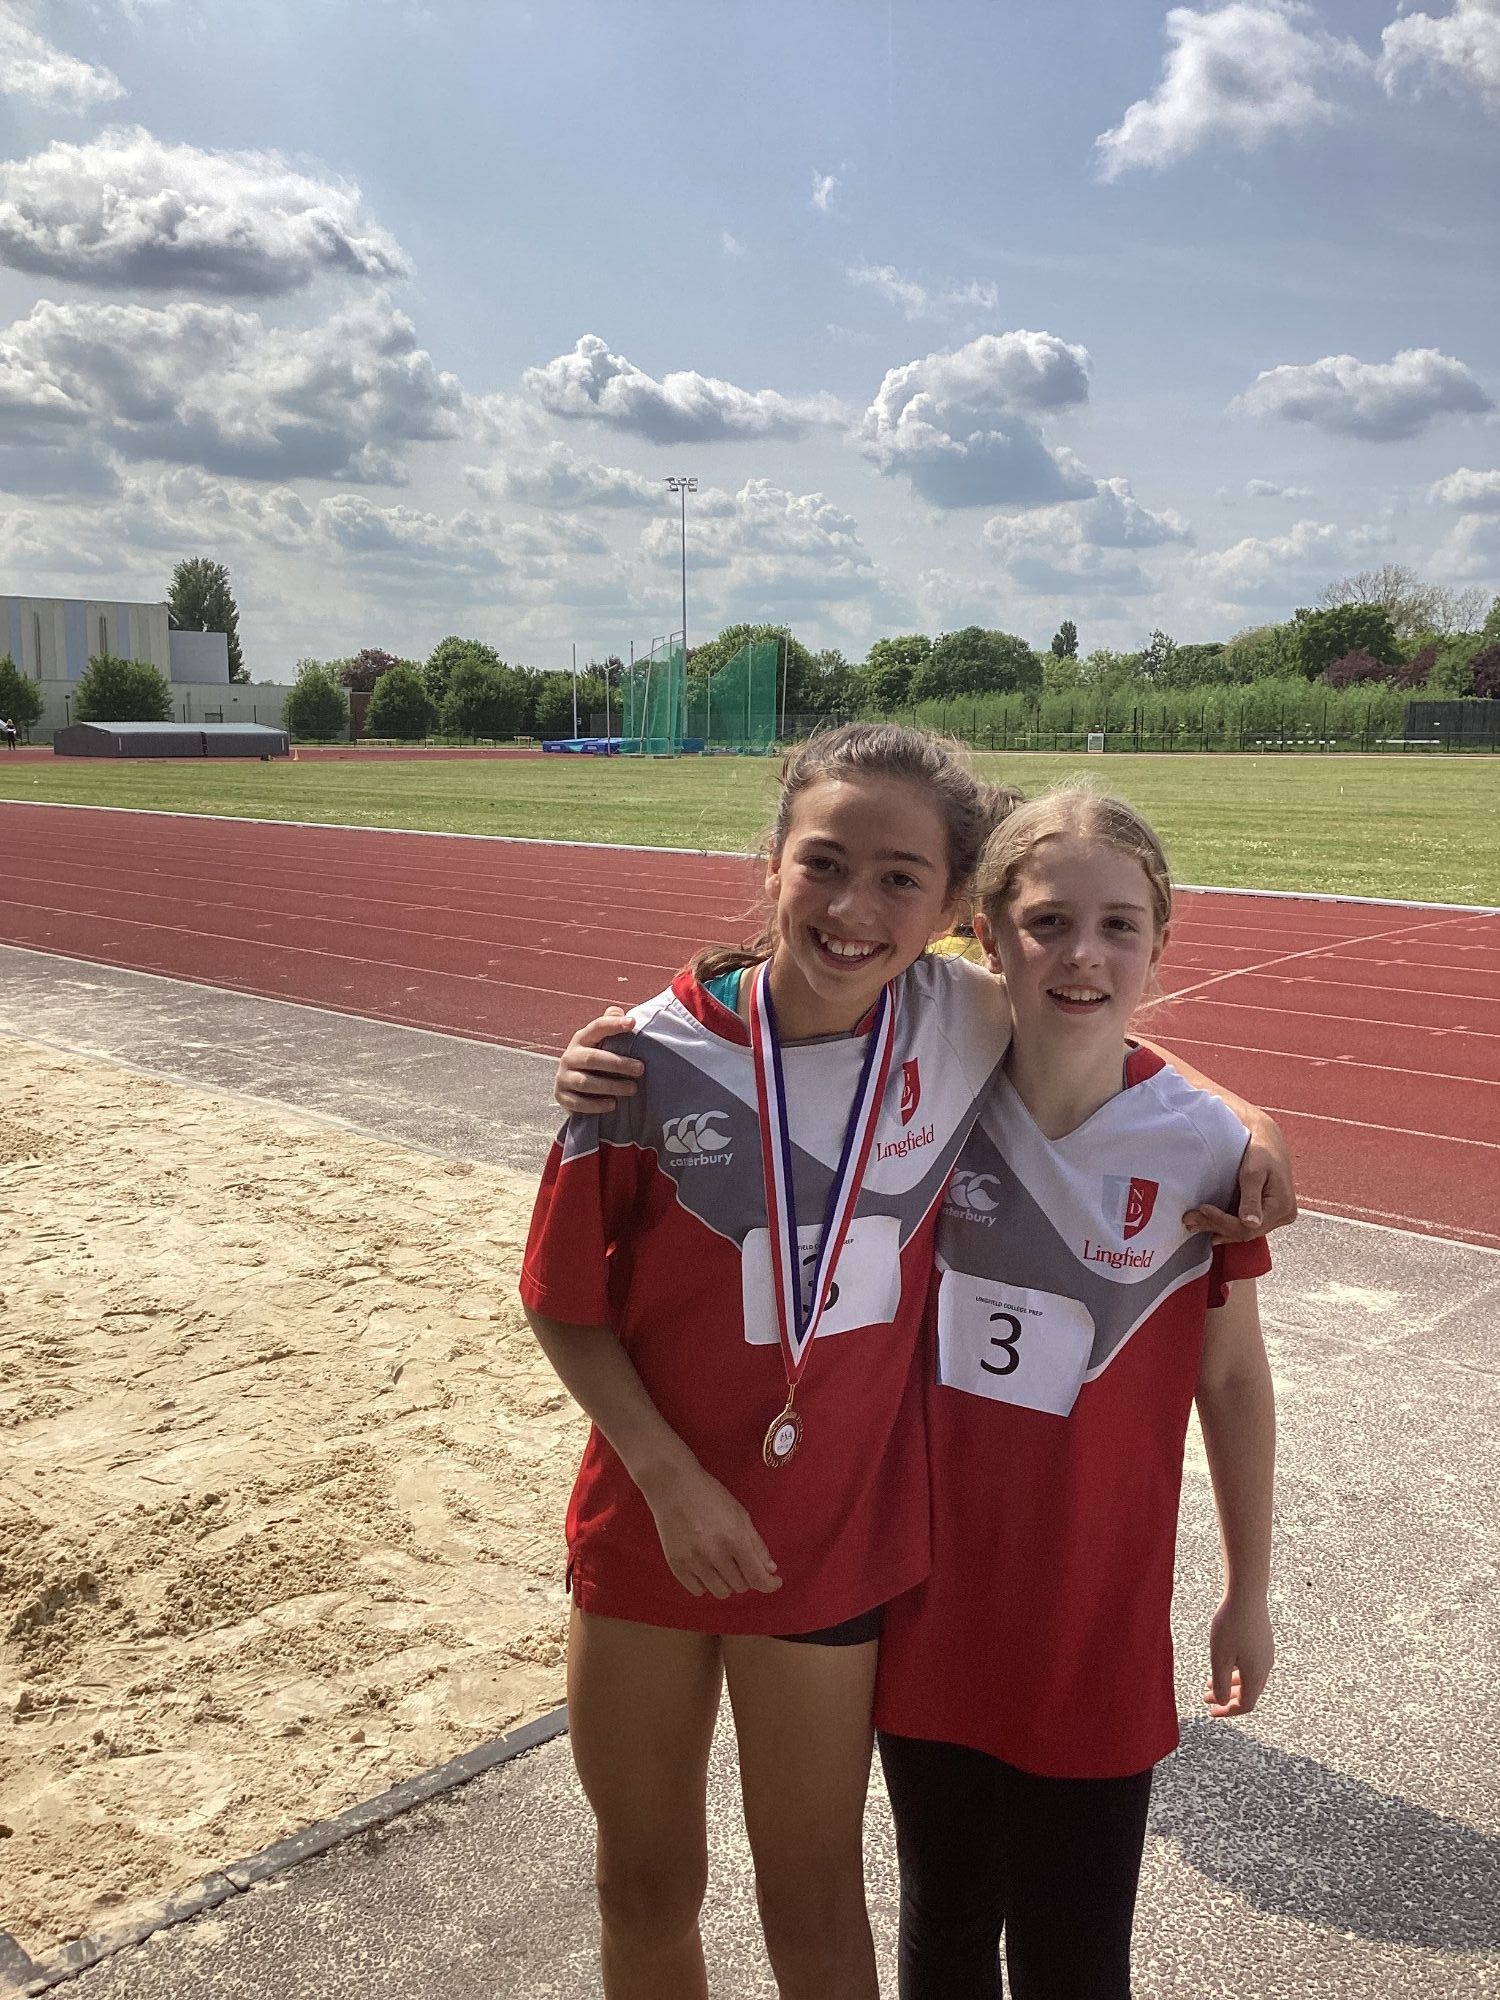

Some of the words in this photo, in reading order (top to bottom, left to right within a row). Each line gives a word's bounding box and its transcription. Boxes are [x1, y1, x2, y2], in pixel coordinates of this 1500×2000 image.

[876, 1123, 935, 1161] Lingfield
[669, 1153, 733, 1167] caerbury
[1083, 1239, 1155, 1269] Lingfield
[975, 1296, 1003, 1307] LINGFIELD
[1003, 1302, 1027, 1314] COLLEGE
[1028, 1308, 1044, 1317] PREP
[980, 1312, 1022, 1375] 3
